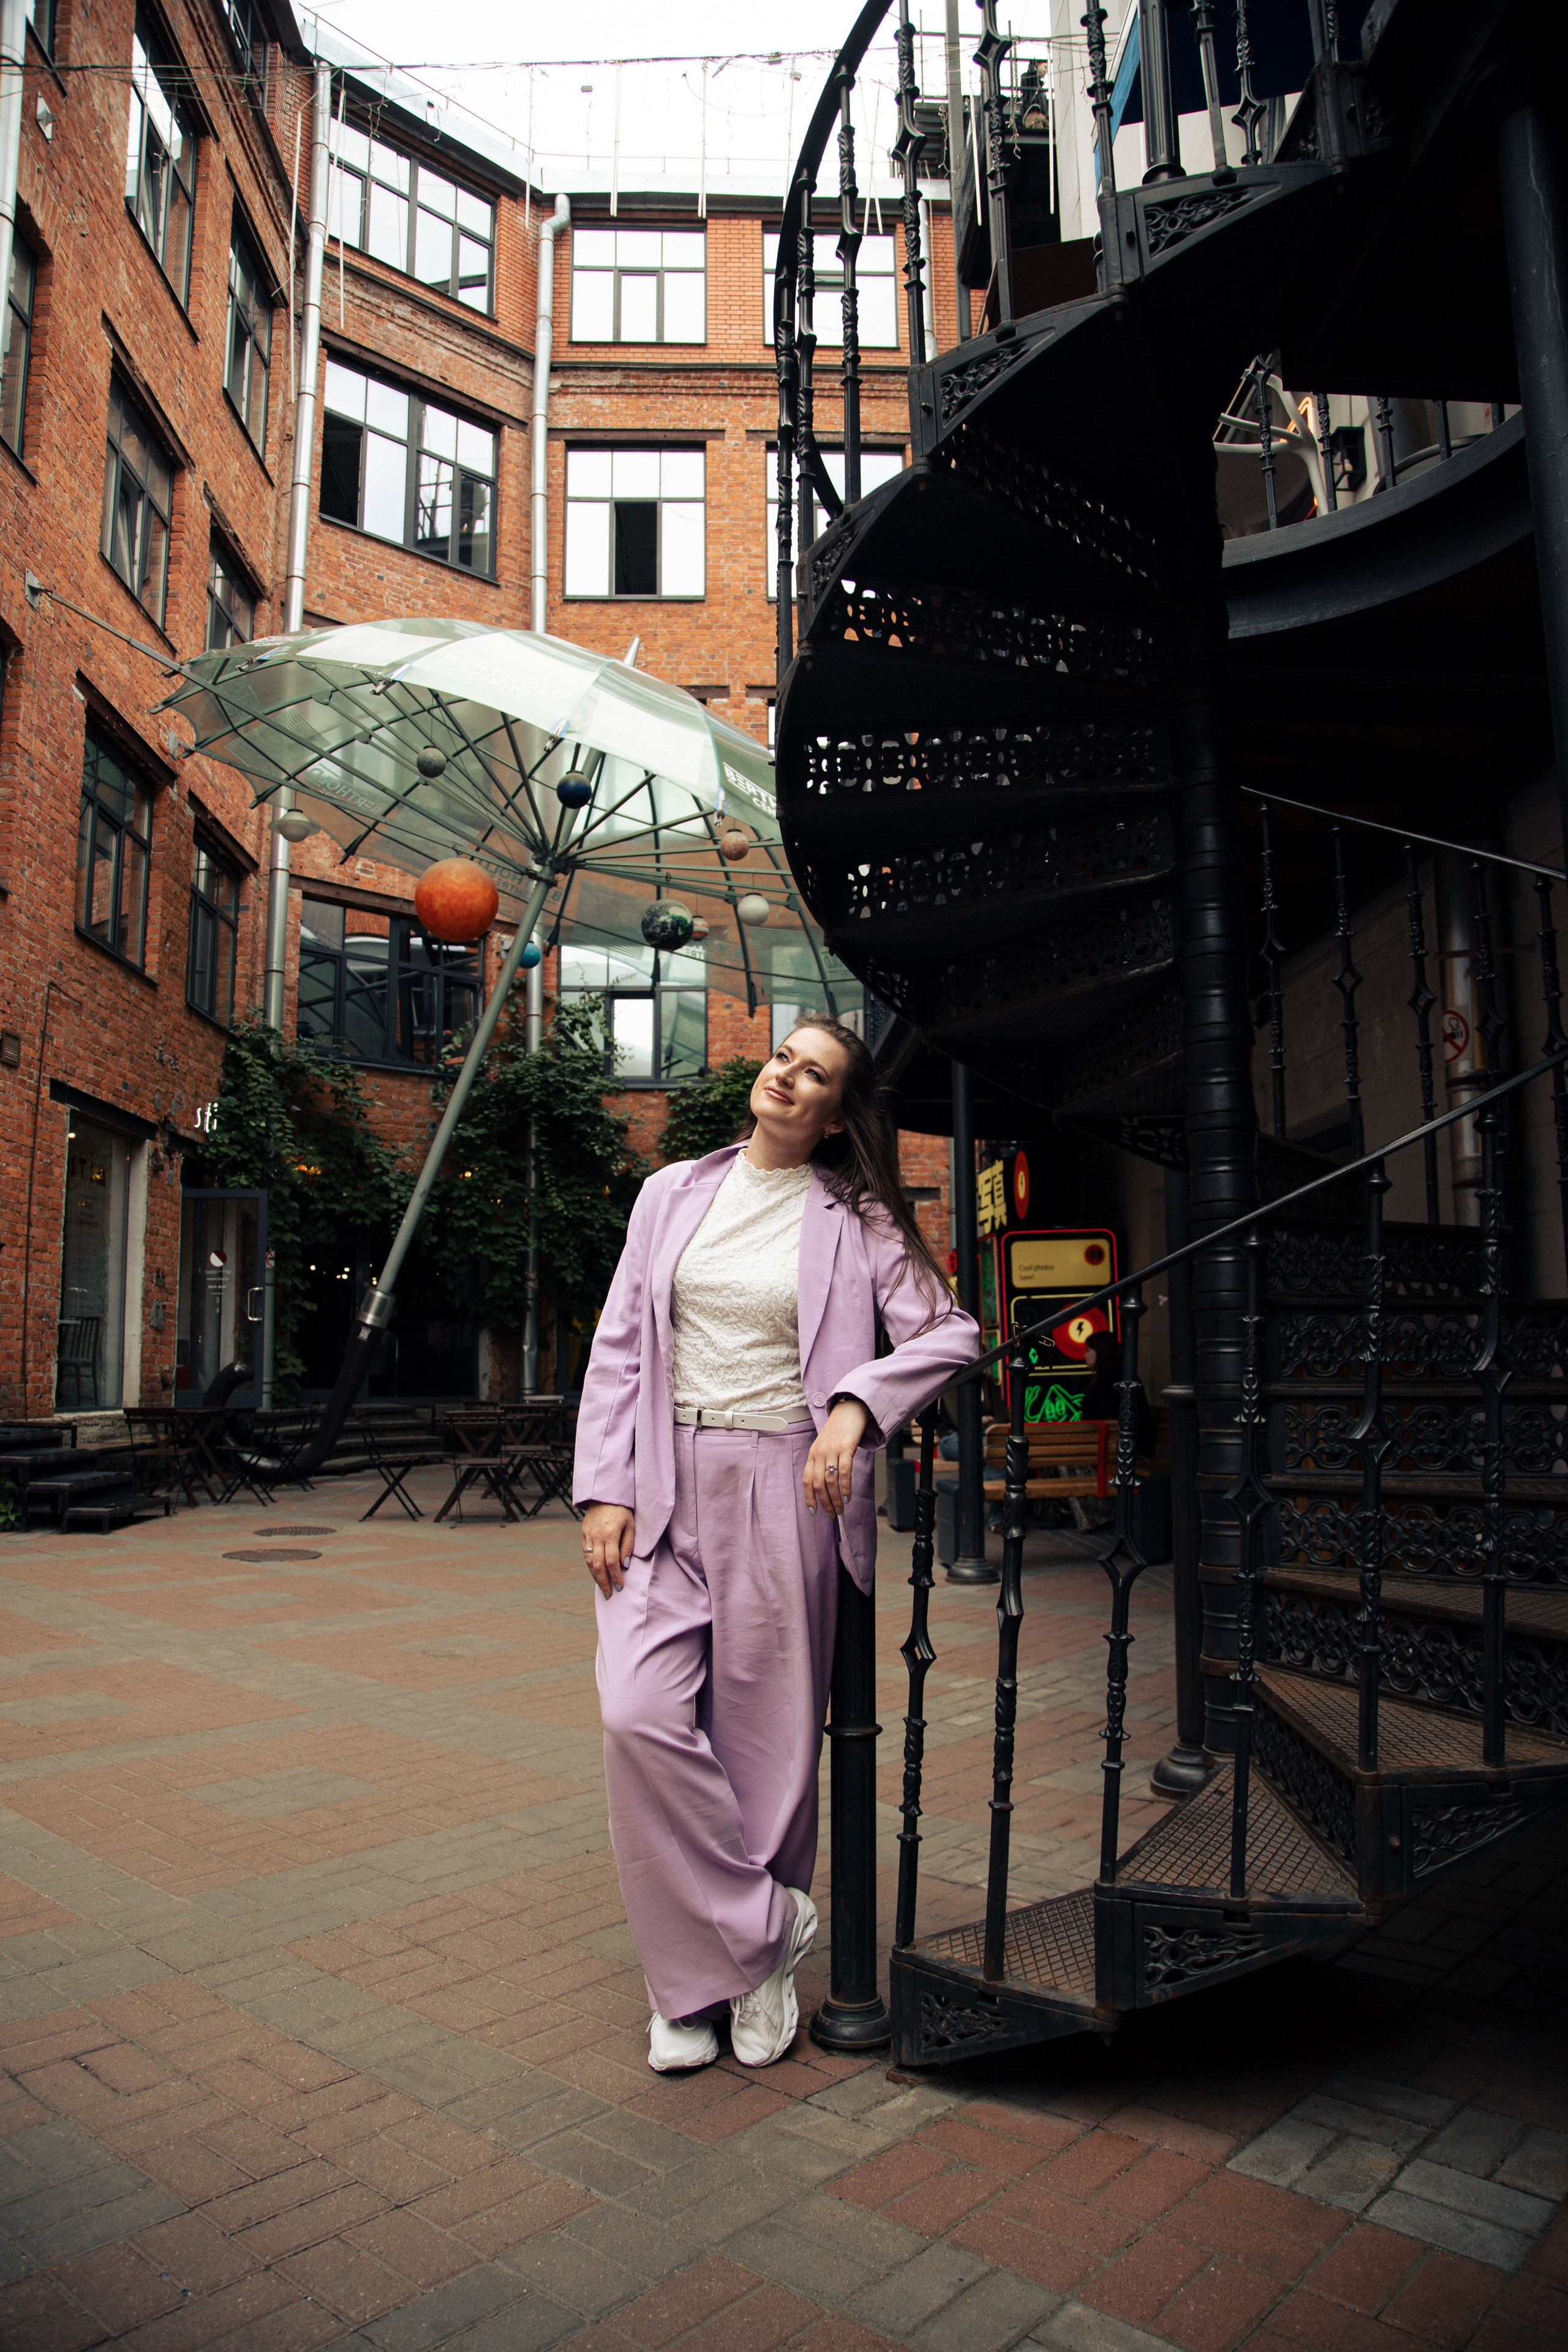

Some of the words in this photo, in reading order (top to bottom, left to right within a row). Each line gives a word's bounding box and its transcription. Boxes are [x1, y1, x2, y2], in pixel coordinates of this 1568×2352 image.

[443, 650, 573, 699] BERTHOLD
[469, 671, 532, 696] CENTRE
[1034, 1264, 1054, 1272] photos
